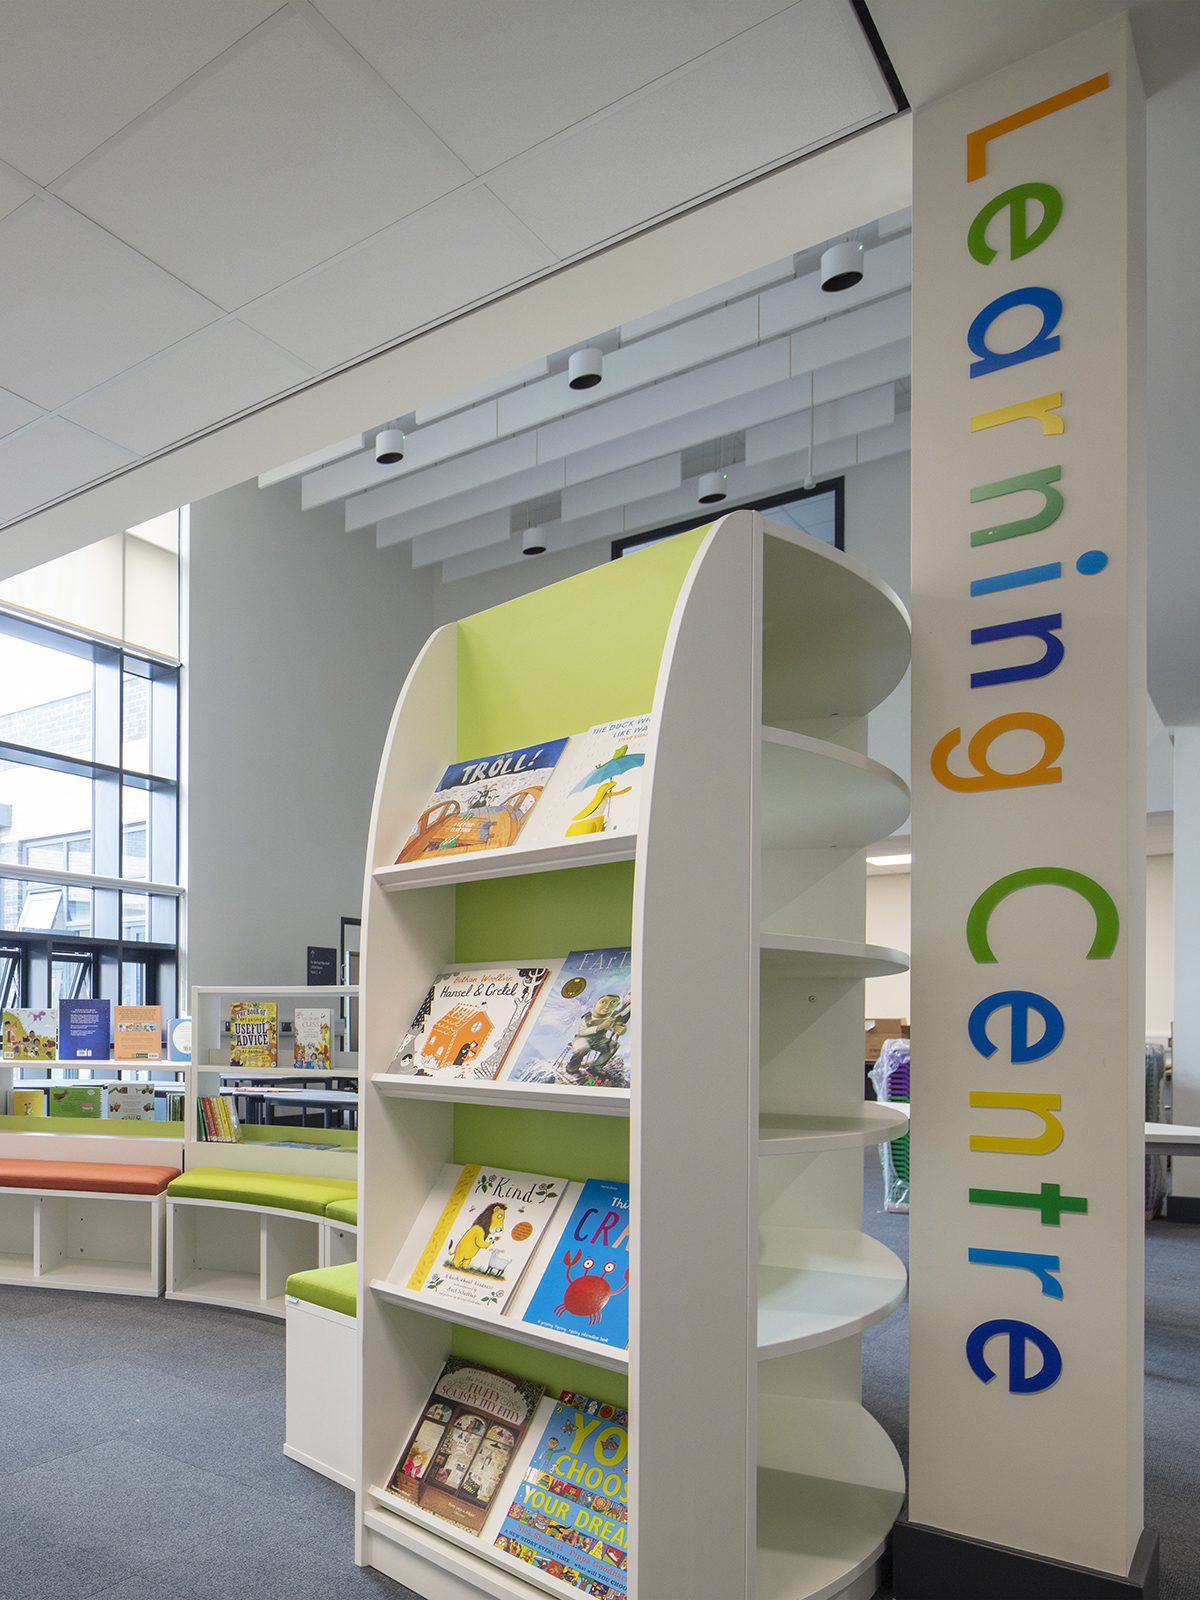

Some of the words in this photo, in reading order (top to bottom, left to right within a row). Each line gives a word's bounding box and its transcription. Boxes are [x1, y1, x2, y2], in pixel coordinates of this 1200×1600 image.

[930, 72, 1109, 793] Learning
[592, 726, 607, 735] THE
[609, 720, 635, 731] DUCK
[613, 729, 631, 738] LIKE
[461, 748, 544, 784] TROLL!
[439, 984, 474, 998] Hansel
[473, 983, 485, 996] &
[485, 982, 519, 996] Gretel
[235, 1023, 267, 1034] USEFUL
[236, 1034, 269, 1046] ADVICE
[965, 866, 1119, 1394] Centre
[492, 1176, 537, 1203] Kind
[611, 1197, 629, 1209] Thi
[441, 1385, 479, 1404] SQUISHY
[479, 1398, 499, 1412] ITTY
[497, 1406, 522, 1422] BITTY
[468, 1383, 501, 1402] FLUFFY
[523, 1486, 570, 1523] YOUR
[516, 1525, 533, 1536] Nick
[533, 1532, 563, 1551] Sharratt
[569, 1549, 591, 1565] Pippa
[573, 1510, 628, 1549] DREA
[509, 1531, 520, 1539] NEW
[520, 1536, 537, 1547] STORY
[538, 1544, 555, 1556] EVERY
[556, 1553, 570, 1564] TIME
[574, 1562, 586, 1571] what
[587, 1568, 597, 1576] will
[598, 1573, 610, 1582] YOU
